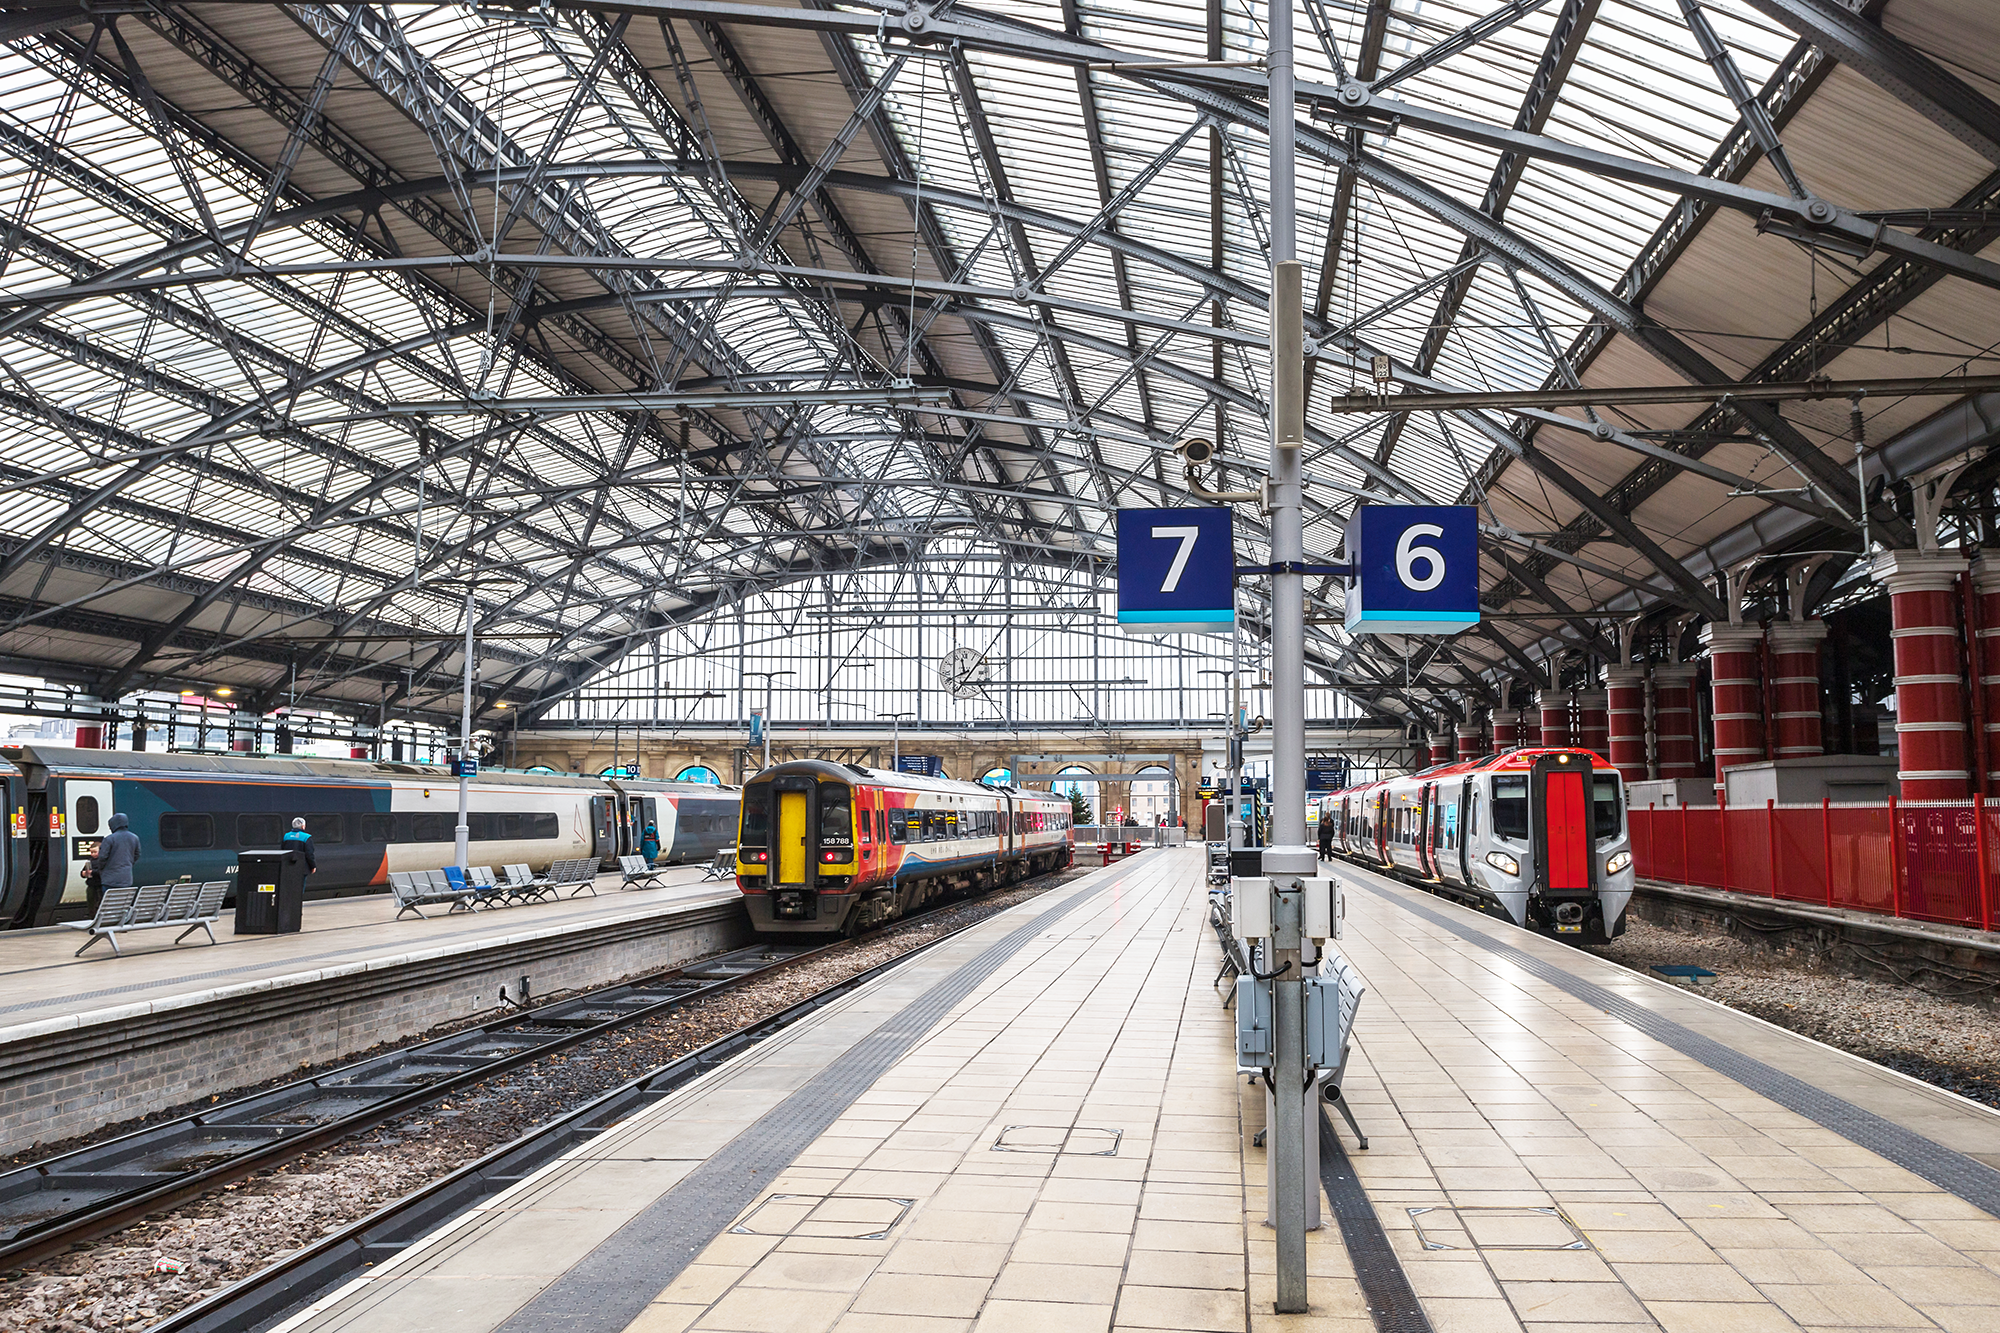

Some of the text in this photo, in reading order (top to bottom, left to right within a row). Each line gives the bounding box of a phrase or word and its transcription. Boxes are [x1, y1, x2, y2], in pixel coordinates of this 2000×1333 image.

[1151, 526, 1199, 592] 7
[1395, 523, 1446, 592] 6
[18, 815, 25, 824] C
[52, 815, 58, 824] B
